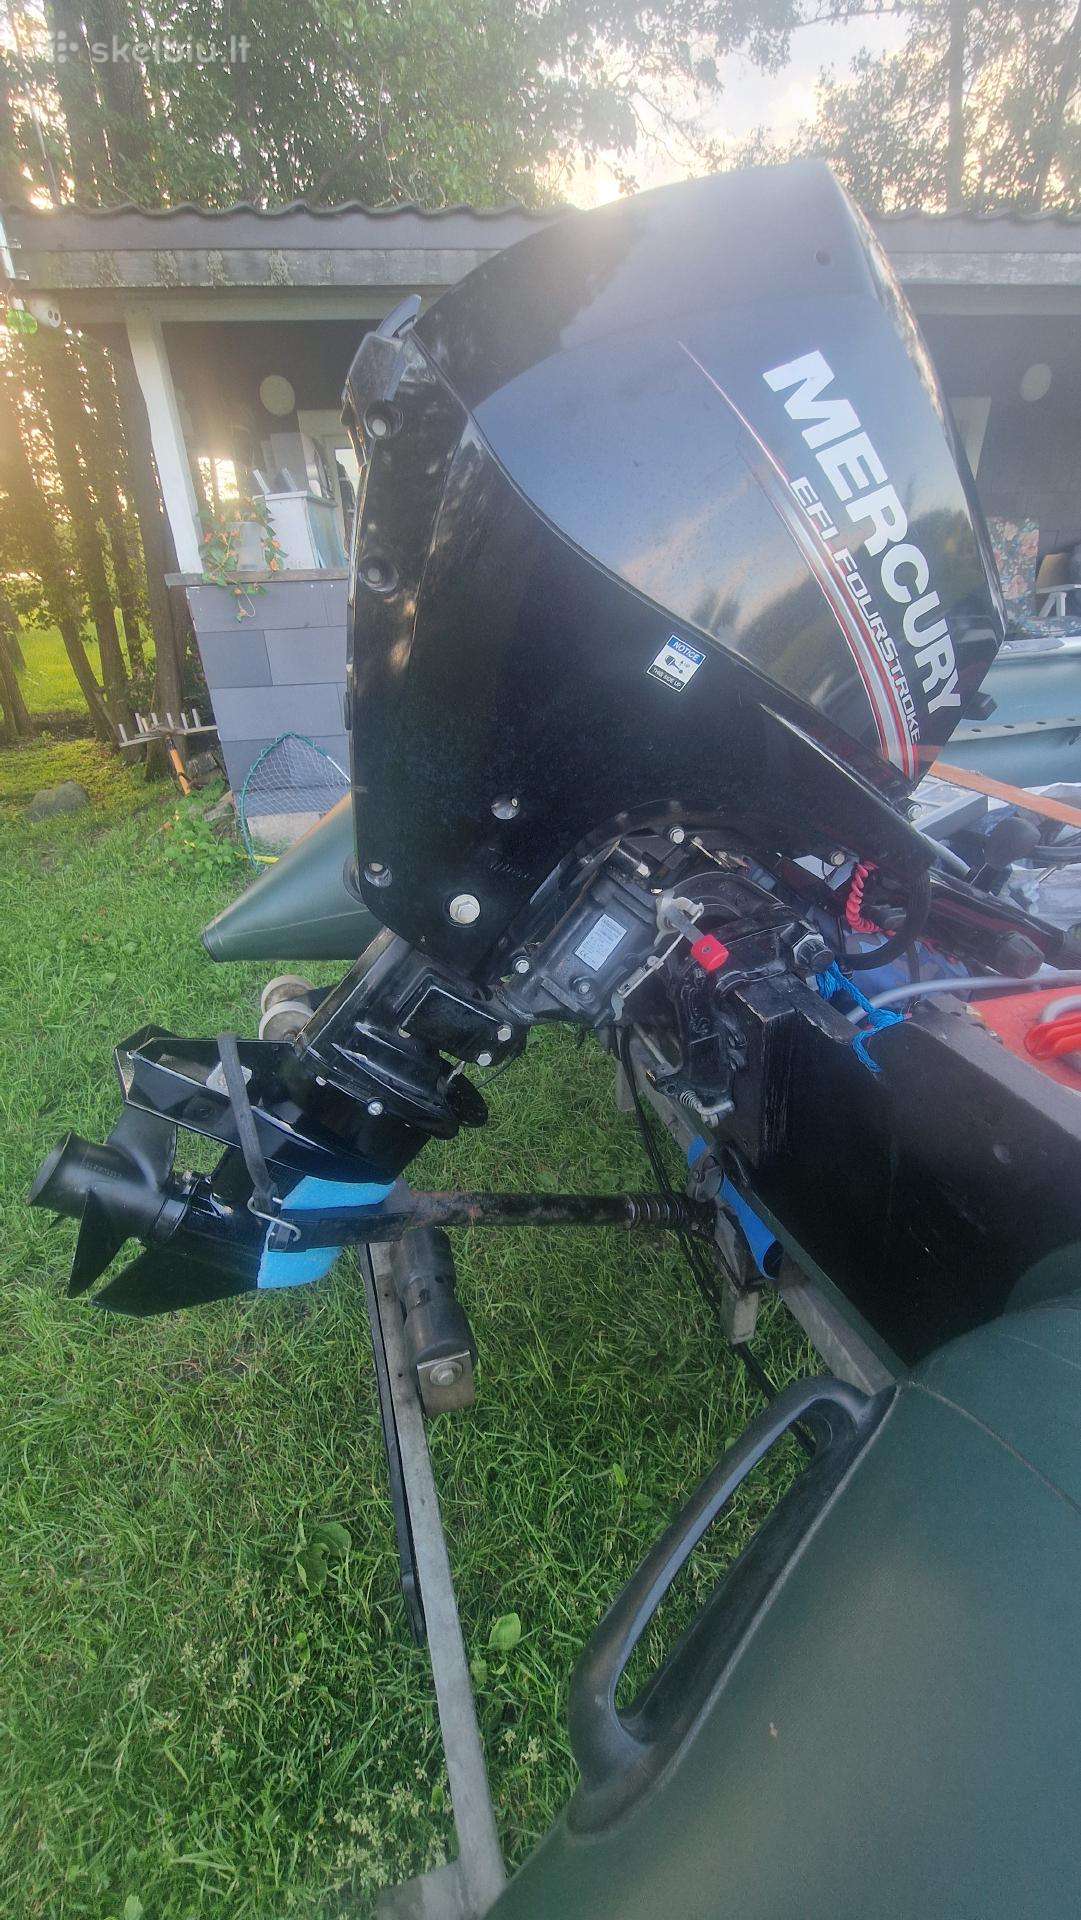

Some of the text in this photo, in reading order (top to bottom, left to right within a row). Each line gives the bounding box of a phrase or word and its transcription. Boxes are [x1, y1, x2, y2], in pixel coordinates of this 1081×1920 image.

[673, 641, 701, 661] NOTICE
[762, 350, 961, 714] MERCURY
[790, 476, 921, 744] EFI FOURSTROKE
